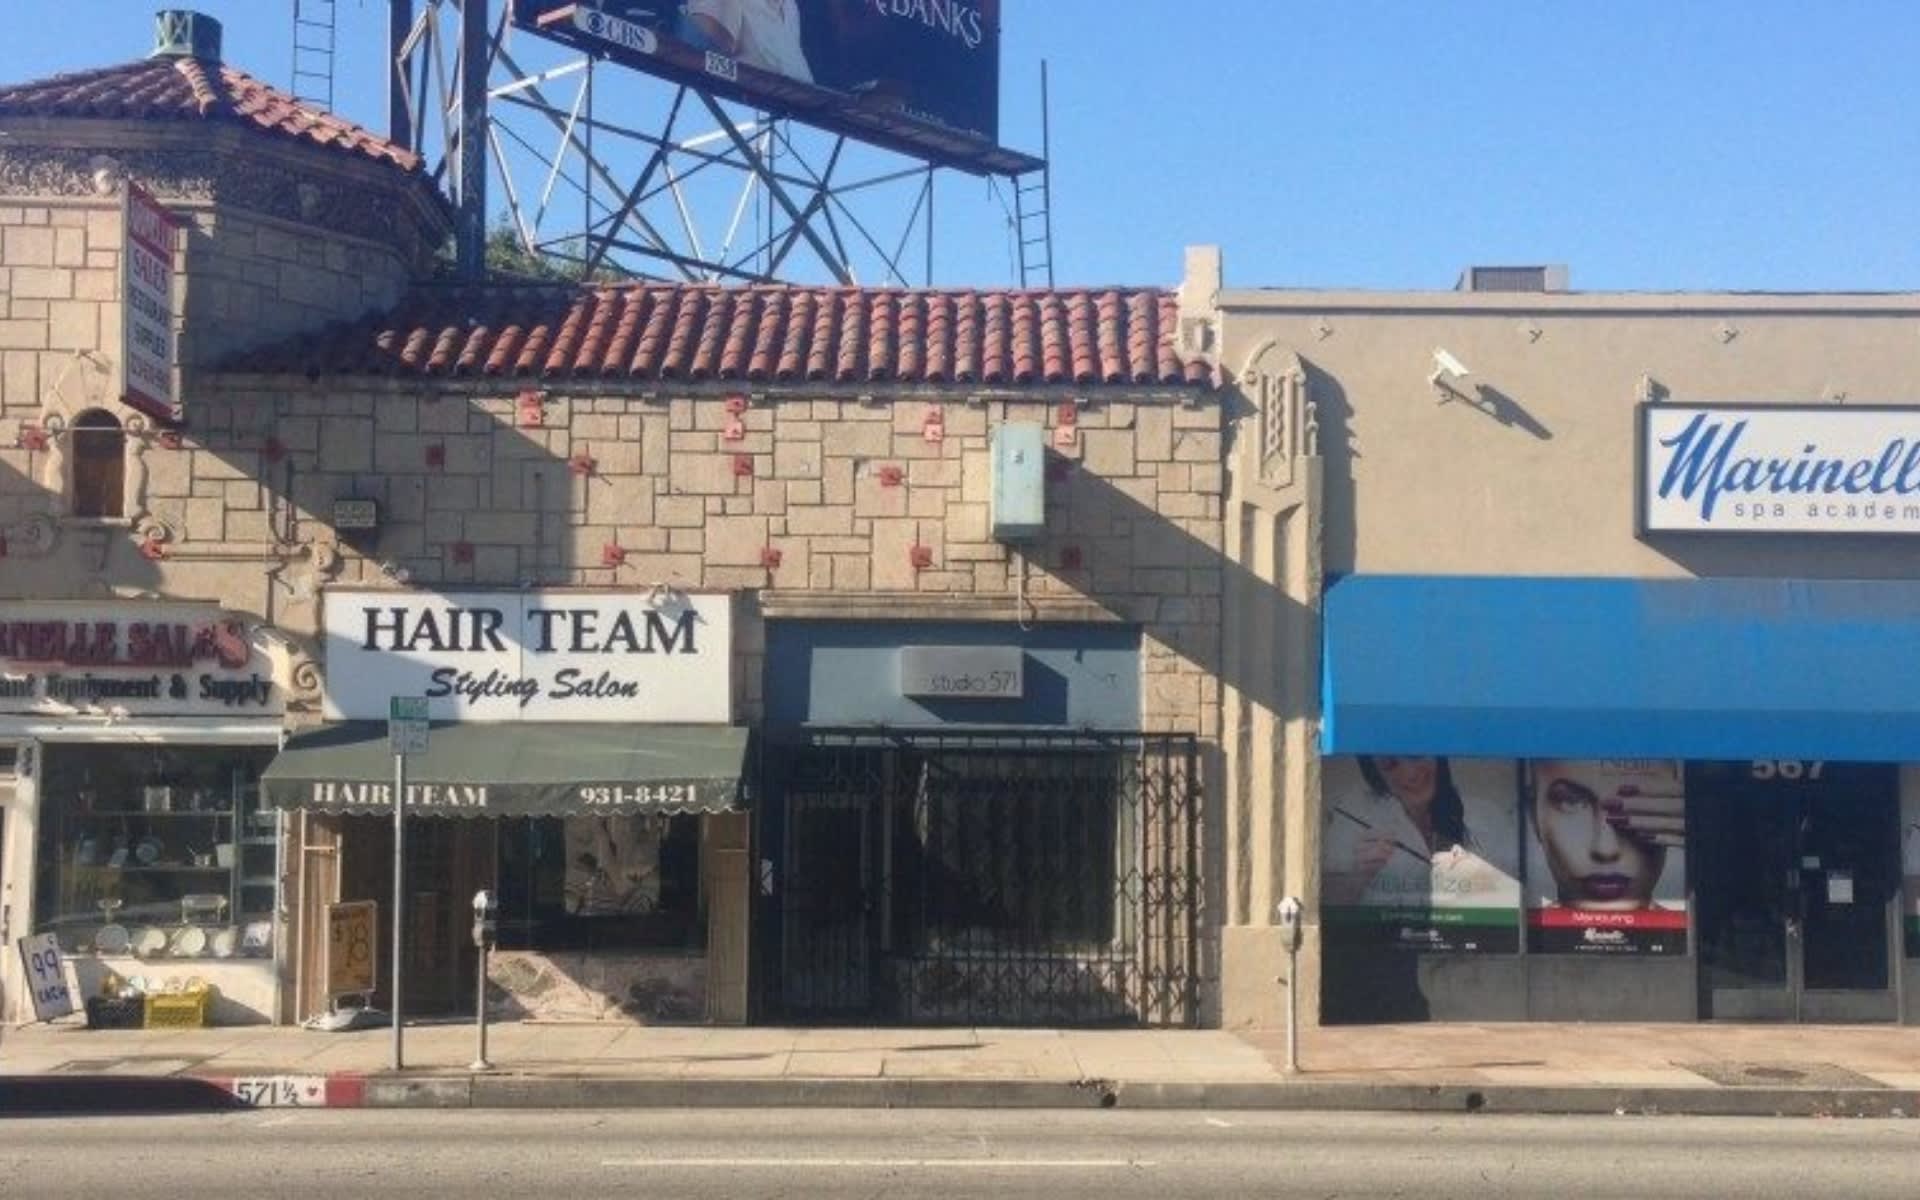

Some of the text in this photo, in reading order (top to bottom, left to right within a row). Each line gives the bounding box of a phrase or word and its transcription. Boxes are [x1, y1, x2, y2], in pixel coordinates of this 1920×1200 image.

[606, 19, 648, 50] CBS
[1734, 502, 1785, 520] spa
[362, 607, 699, 655] HAIR TEAM
[46, 673, 160, 704] Equipment
[169, 673, 187, 700] &
[199, 673, 273, 706] Supply
[425, 668, 640, 706] Styling Salon
[930, 672, 985, 693] studio
[313, 782, 697, 807] HAIR TEAM 931-8421
[237, 1080, 278, 1105] 571
